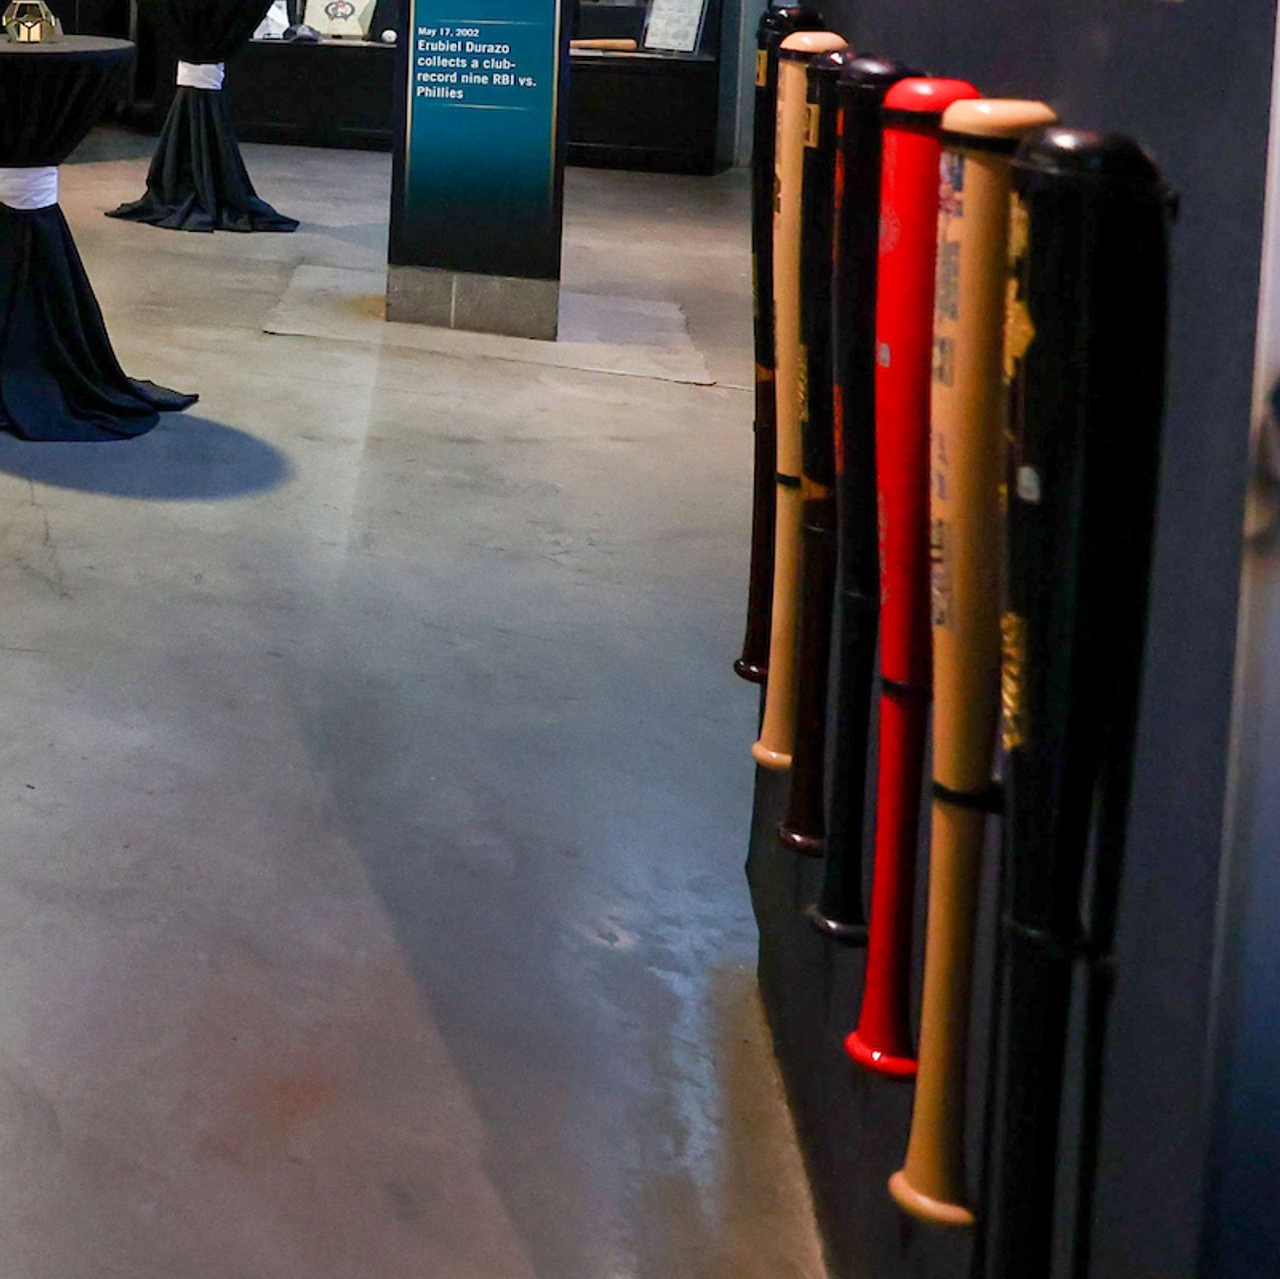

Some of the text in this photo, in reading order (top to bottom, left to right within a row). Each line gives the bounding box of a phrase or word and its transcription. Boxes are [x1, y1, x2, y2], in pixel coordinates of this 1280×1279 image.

[417, 27, 479, 38] May 17, 2002
[417, 39, 510, 54] Erubiel Durazo
[417, 56, 516, 70] collects a club-
[417, 71, 537, 87] record nine RBI vs.
[416, 86, 464, 100] Phillies
